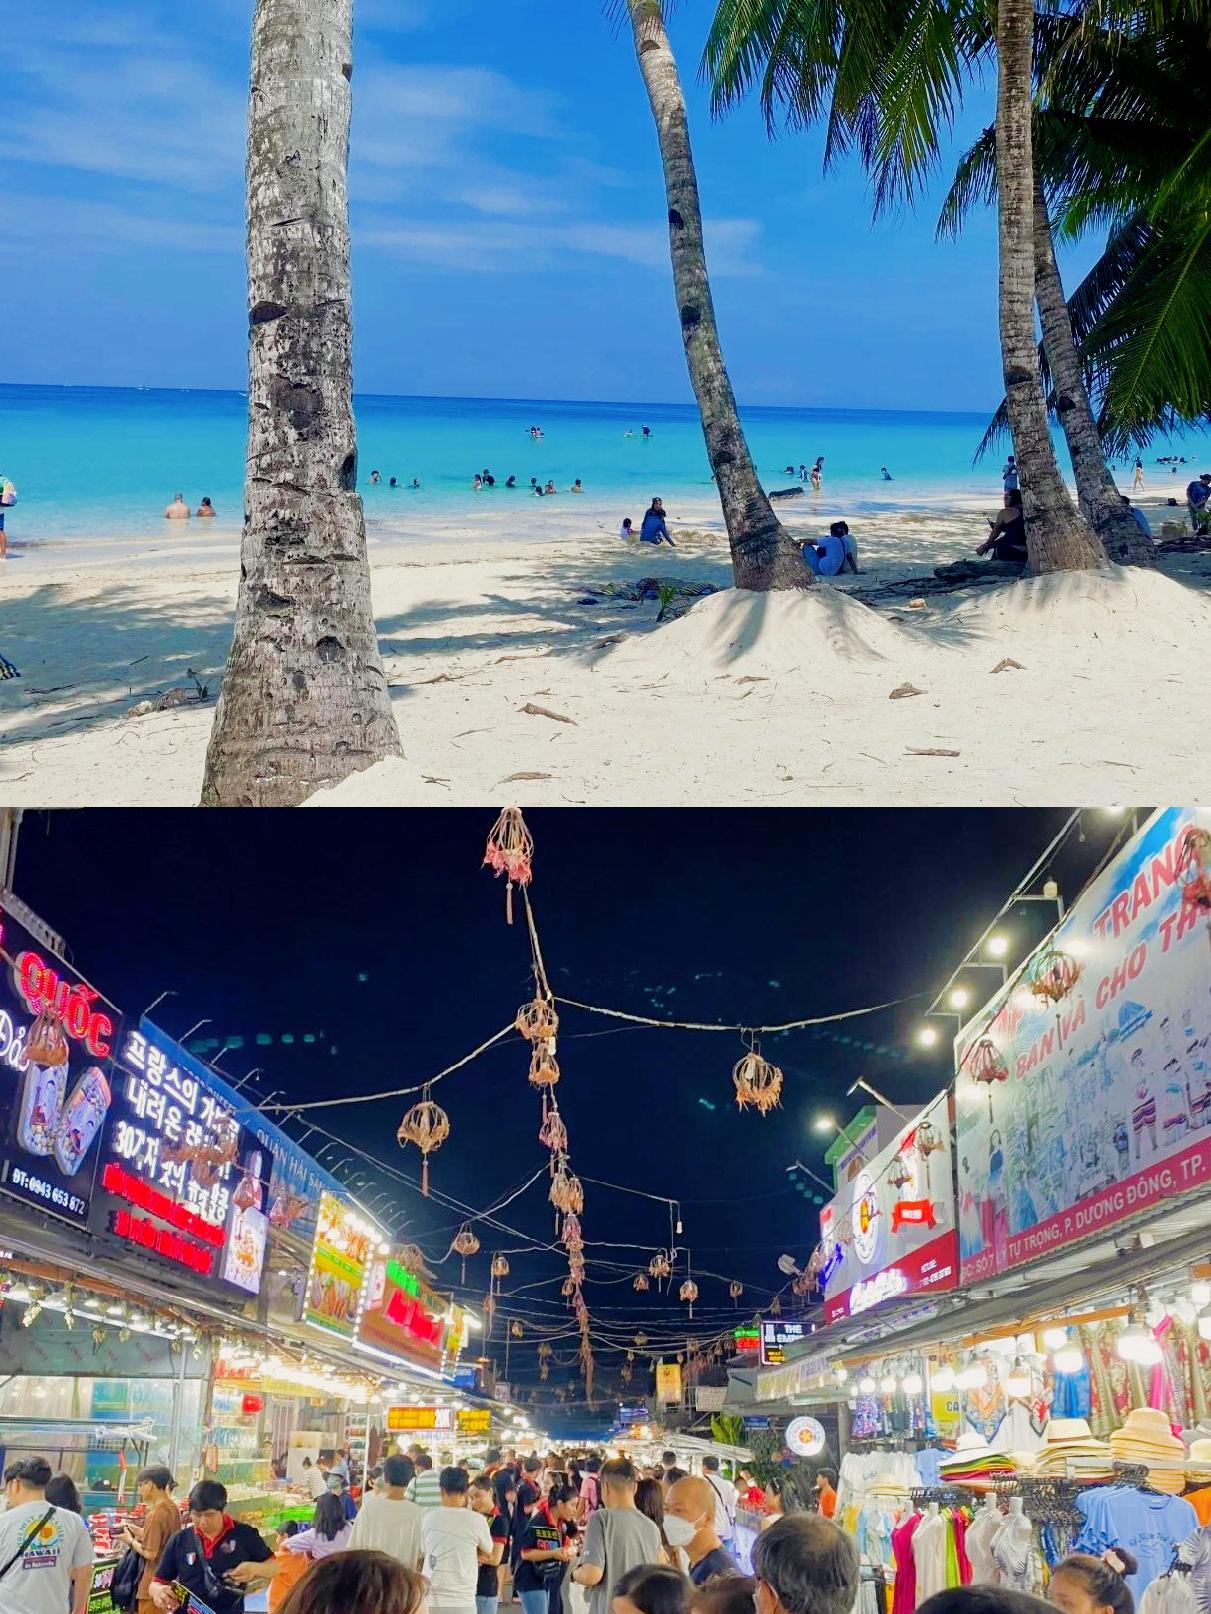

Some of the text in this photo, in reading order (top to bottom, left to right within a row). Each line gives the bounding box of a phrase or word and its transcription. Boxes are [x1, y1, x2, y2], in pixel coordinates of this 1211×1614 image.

[1096, 945, 1147, 1010] CHO
[126, 1031, 199, 1115] 프랑스의
[1180, 1154, 1207, 1180] TP.
[784, 1324, 803, 1334] THE
